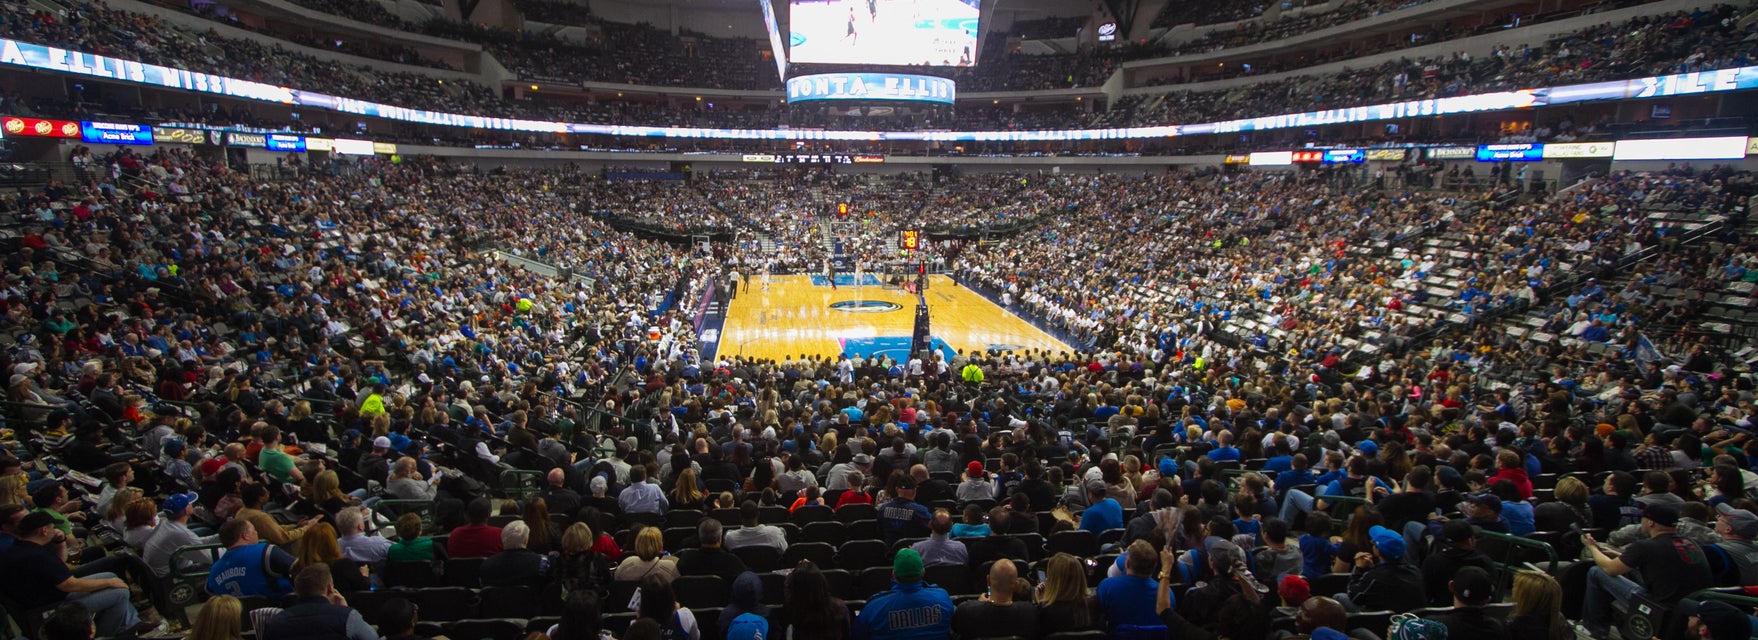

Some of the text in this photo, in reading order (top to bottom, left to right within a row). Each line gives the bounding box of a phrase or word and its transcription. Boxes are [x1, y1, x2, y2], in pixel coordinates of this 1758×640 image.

[48, 46, 146, 82] ELLIS
[790, 76, 949, 99] MONTA ELLIS
[120, 132, 136, 141] Brick
[215, 566, 247, 586] BEAUBOIS
[888, 603, 943, 631] DALLAS
